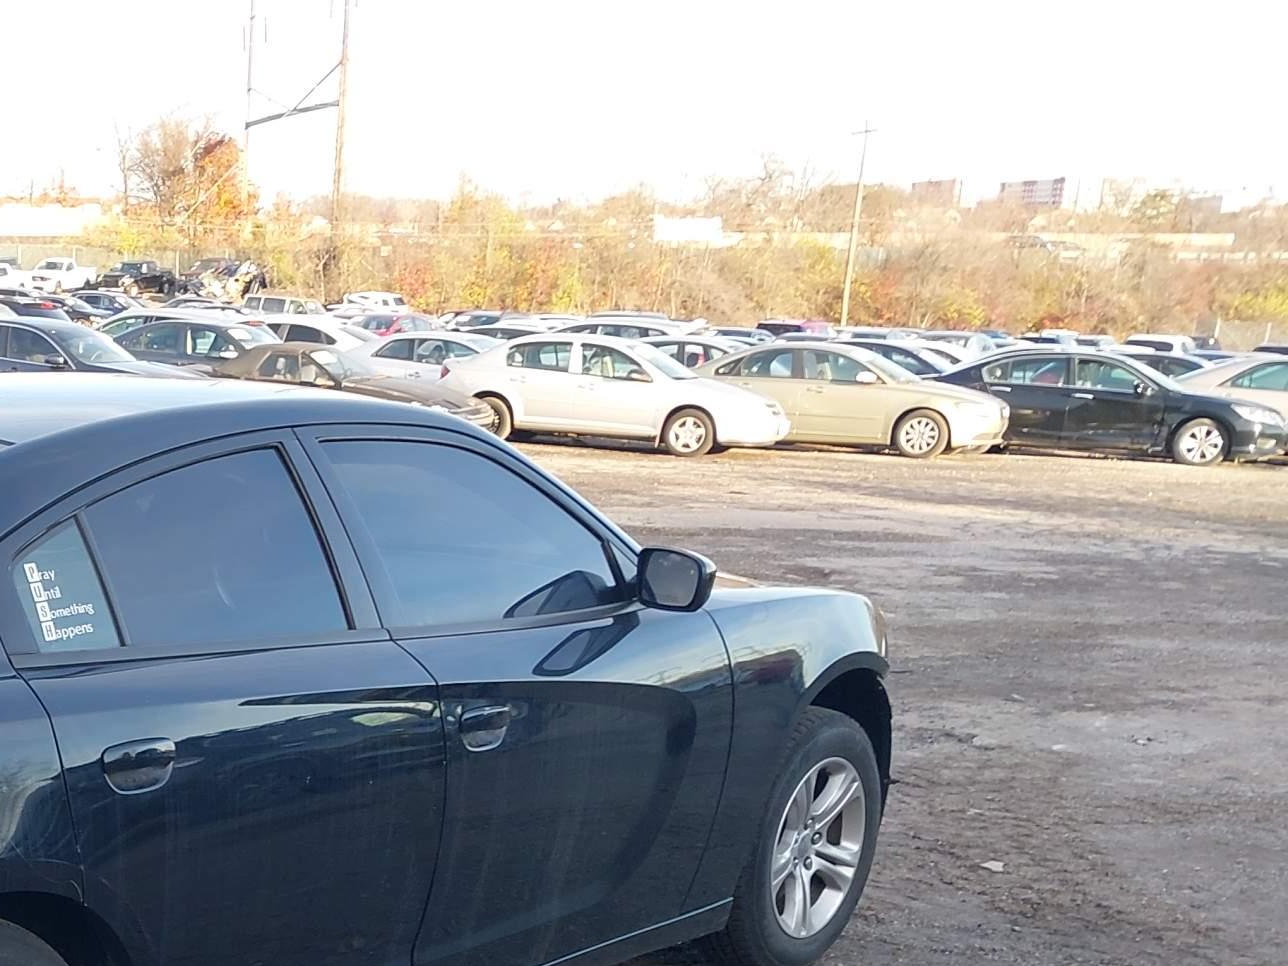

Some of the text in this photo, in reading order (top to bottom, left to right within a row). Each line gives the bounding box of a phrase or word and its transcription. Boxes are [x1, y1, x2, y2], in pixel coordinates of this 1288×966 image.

[24, 562, 55, 582] Pray
[30, 582, 63, 602] Until
[36, 602, 95, 622] Something
[42, 621, 94, 641] Happens
